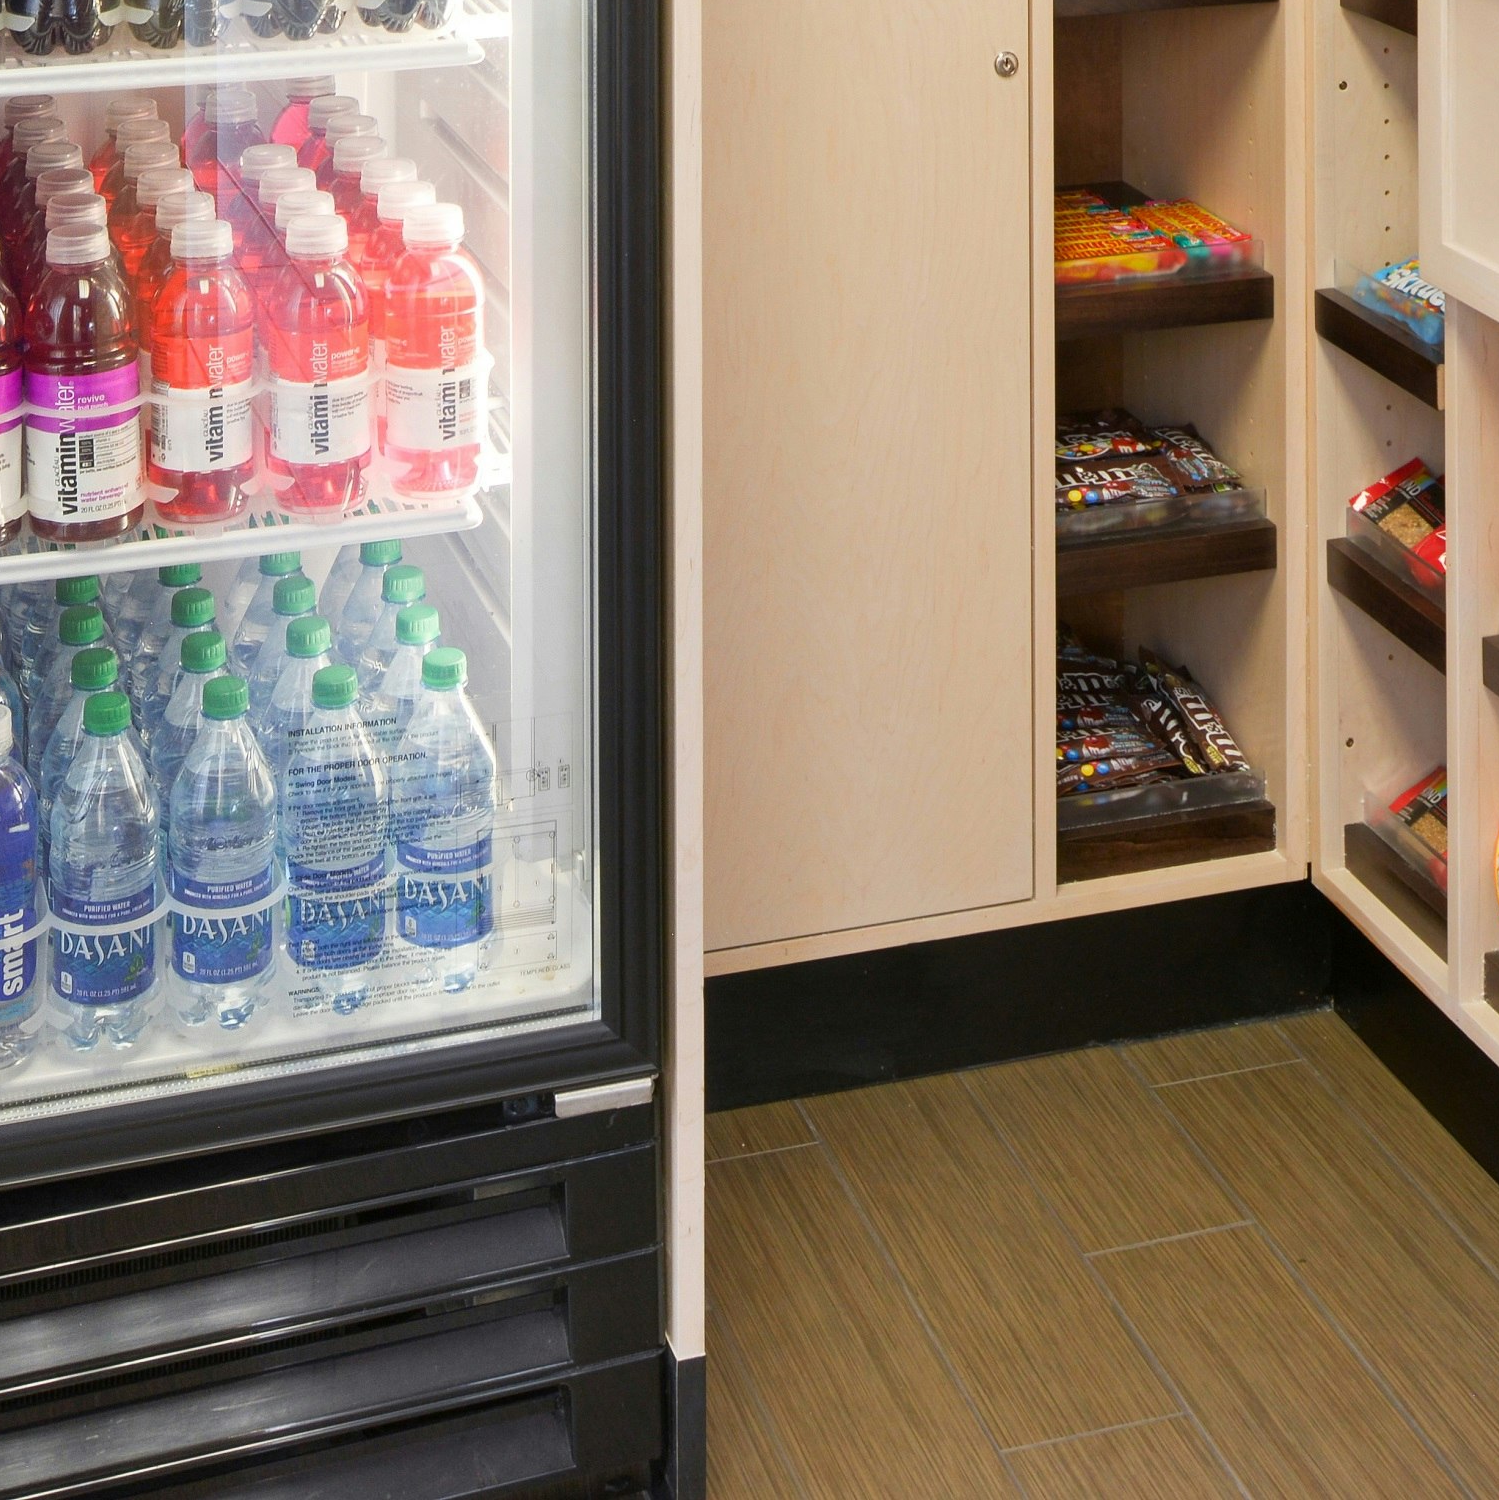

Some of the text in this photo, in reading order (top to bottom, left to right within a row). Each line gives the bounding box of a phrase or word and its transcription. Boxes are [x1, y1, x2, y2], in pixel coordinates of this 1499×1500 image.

[77, 393, 106, 404] revive
[288, 717, 397, 738] INSTALLATION INFORMATION
[288, 757, 381, 777] FOR THE PROPER DOOR
[207, 883, 235, 893] PURIFIED
[236, 880, 253, 891] WATER
[404, 874, 492, 911] DASANI
[84, 903, 112, 913] PURIFIED
[112, 900, 132, 911] WATER
[182, 908, 271, 945] DASANI
[60, 924, 151, 967] DASANI
